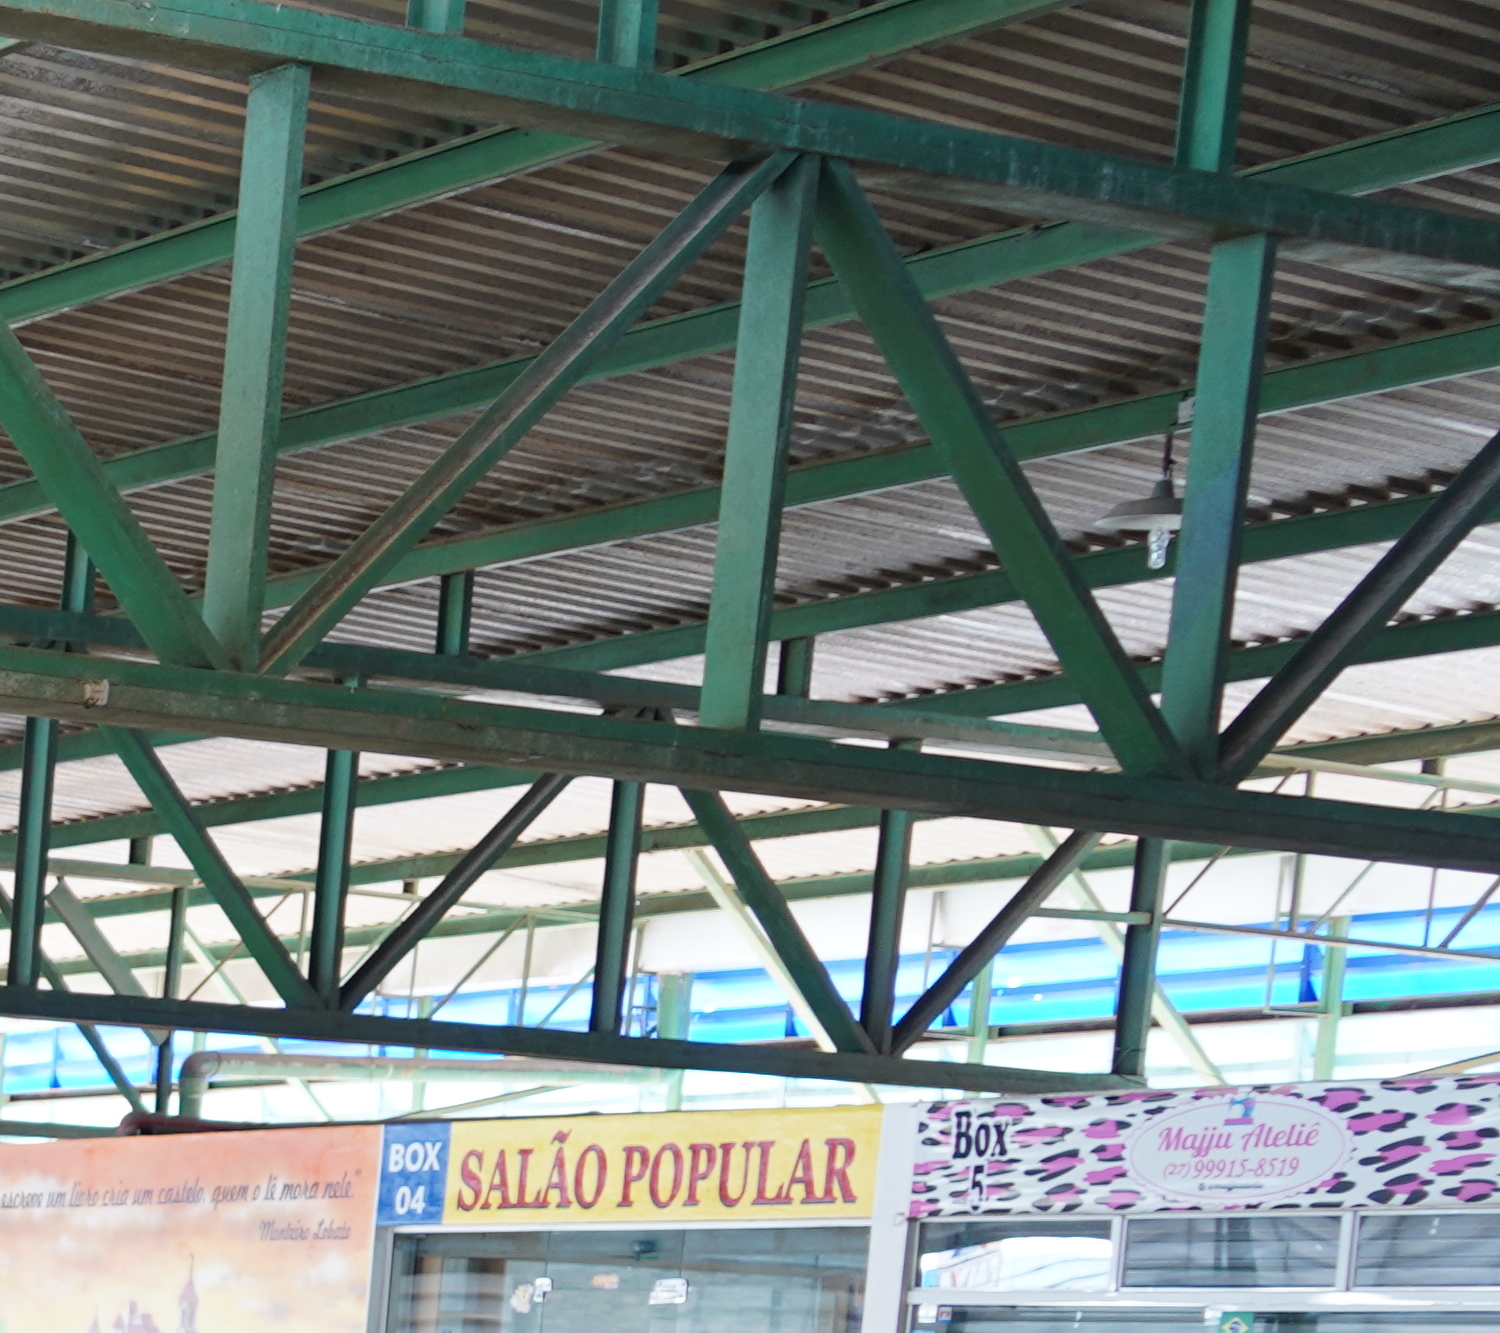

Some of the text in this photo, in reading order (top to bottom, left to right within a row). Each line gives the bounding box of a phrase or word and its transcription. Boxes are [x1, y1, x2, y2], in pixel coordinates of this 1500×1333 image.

[953, 1110, 1008, 1158] Box
[1157, 1124, 1235, 1159] Majju
[388, 1141, 440, 1173] BOX
[457, 1128, 857, 1211] SALÃO POPULAR
[1163, 1156, 1299, 1179] (27) 99915-8519
[47, 1191, 66, 1207] um
[68, 1181, 98, 1208] livro
[101, 1180, 129, 1207] cria
[132, 1188, 152, 1206] um
[211, 1184, 249, 1210] quem
[280, 1180, 320, 1200] mora
[970, 1164, 985, 1201] 5
[394, 1186, 425, 1215] 04
[259, 1218, 352, 1241] Monteiro Lobato
